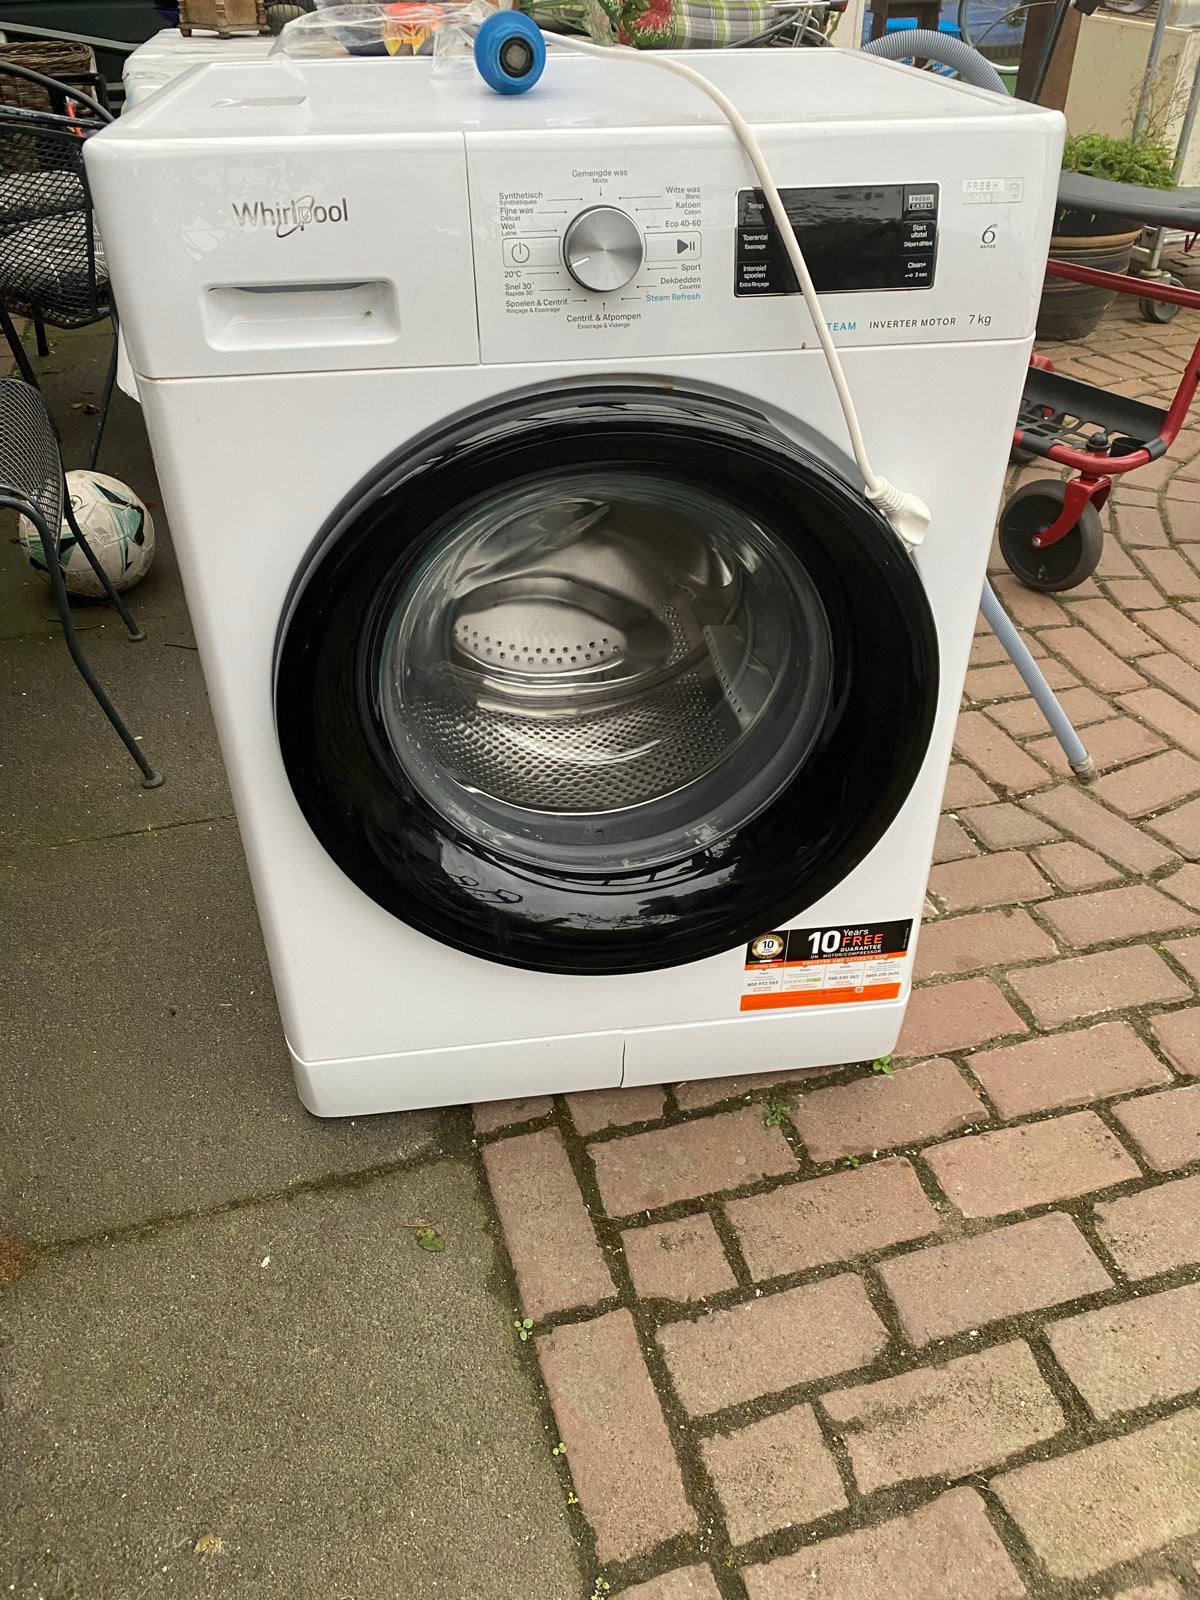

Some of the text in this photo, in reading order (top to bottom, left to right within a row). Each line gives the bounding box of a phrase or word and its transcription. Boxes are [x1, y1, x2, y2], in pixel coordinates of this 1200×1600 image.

[572, 170, 612, 178] Gemengde
[666, 186, 685, 194] Witte
[499, 191, 543, 200] Synthetisch
[676, 201, 702, 209] Katoen
[500, 206, 518, 216] Fijne
[232, 196, 348, 238] Whirlpool
[501, 222, 516, 230] Wol
[680, 219, 702, 227] 40-60
[743, 233, 769, 241] Toerental
[681, 263, 702, 271] Sport
[743, 264, 767, 272] Intensief
[907, 261, 927, 269] Clean+
[504, 270, 521, 278] 20°C
[744, 272, 766, 280] spoelen
[660, 276, 702, 285] Dekbedden
[505, 283, 521, 291] Snel
[646, 293, 701, 302] Steam Refresh
[505, 300, 536, 308] Spoelen
[543, 298, 569, 306] Centrif.
[566, 314, 594, 323] Centrif.
[602, 313, 642, 322] Afpompen
[969, 313, 992, 327] 7 kg
[826, 321, 857, 331] TEAM
[869, 317, 956, 329] INVERTER MOTOR
[843, 928, 869, 937] Years
[762, 940, 774, 949] 10
[808, 930, 842, 955] 10
[842, 933, 884, 947] FREE
[840, 944, 882, 952] GUARANTEE
